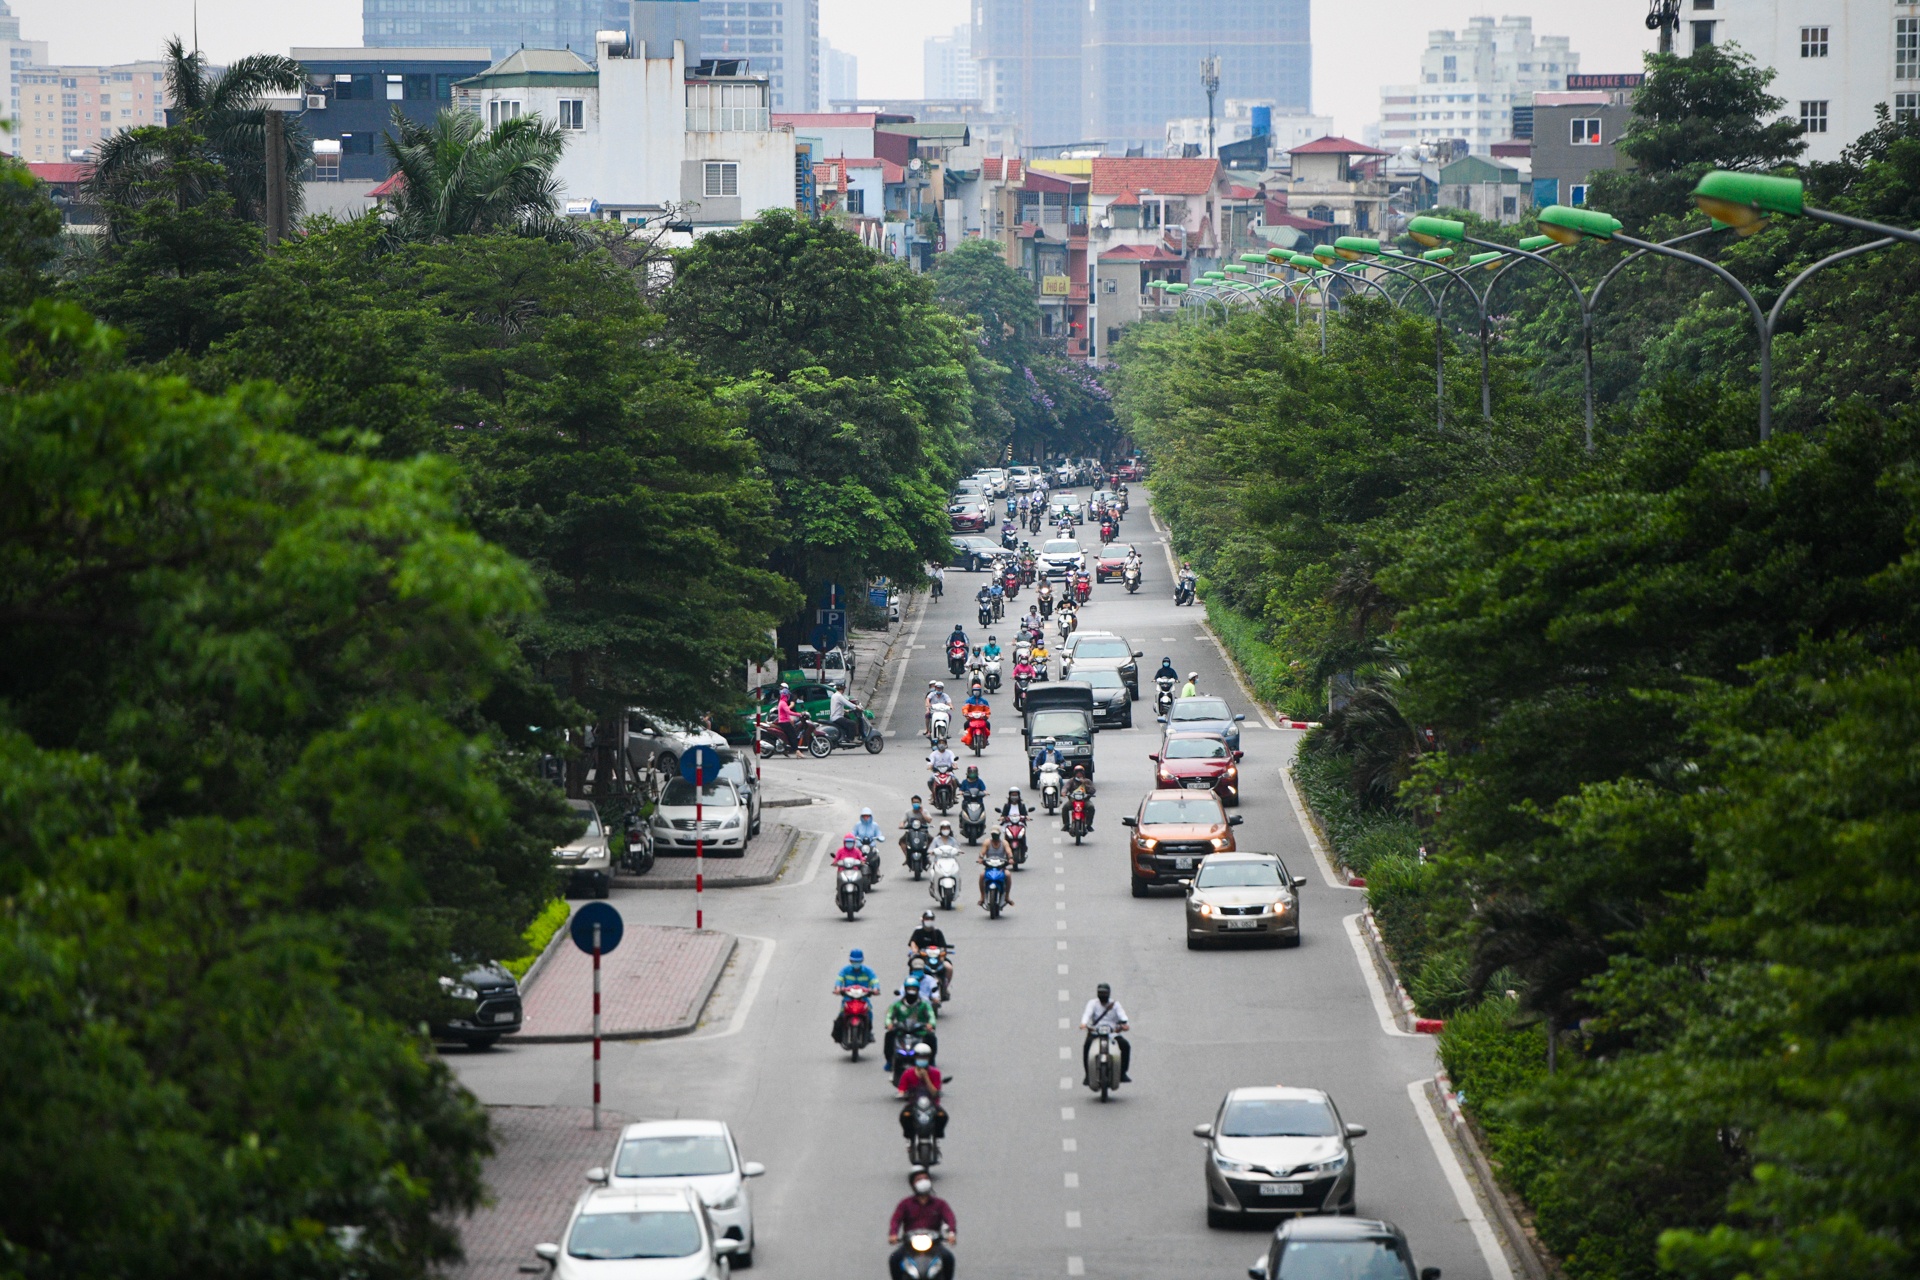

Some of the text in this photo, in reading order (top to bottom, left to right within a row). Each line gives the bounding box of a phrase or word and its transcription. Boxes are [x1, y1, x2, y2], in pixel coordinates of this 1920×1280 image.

[1569, 75, 1641, 87] KARAOKE 107
[828, 612, 839, 625] P
